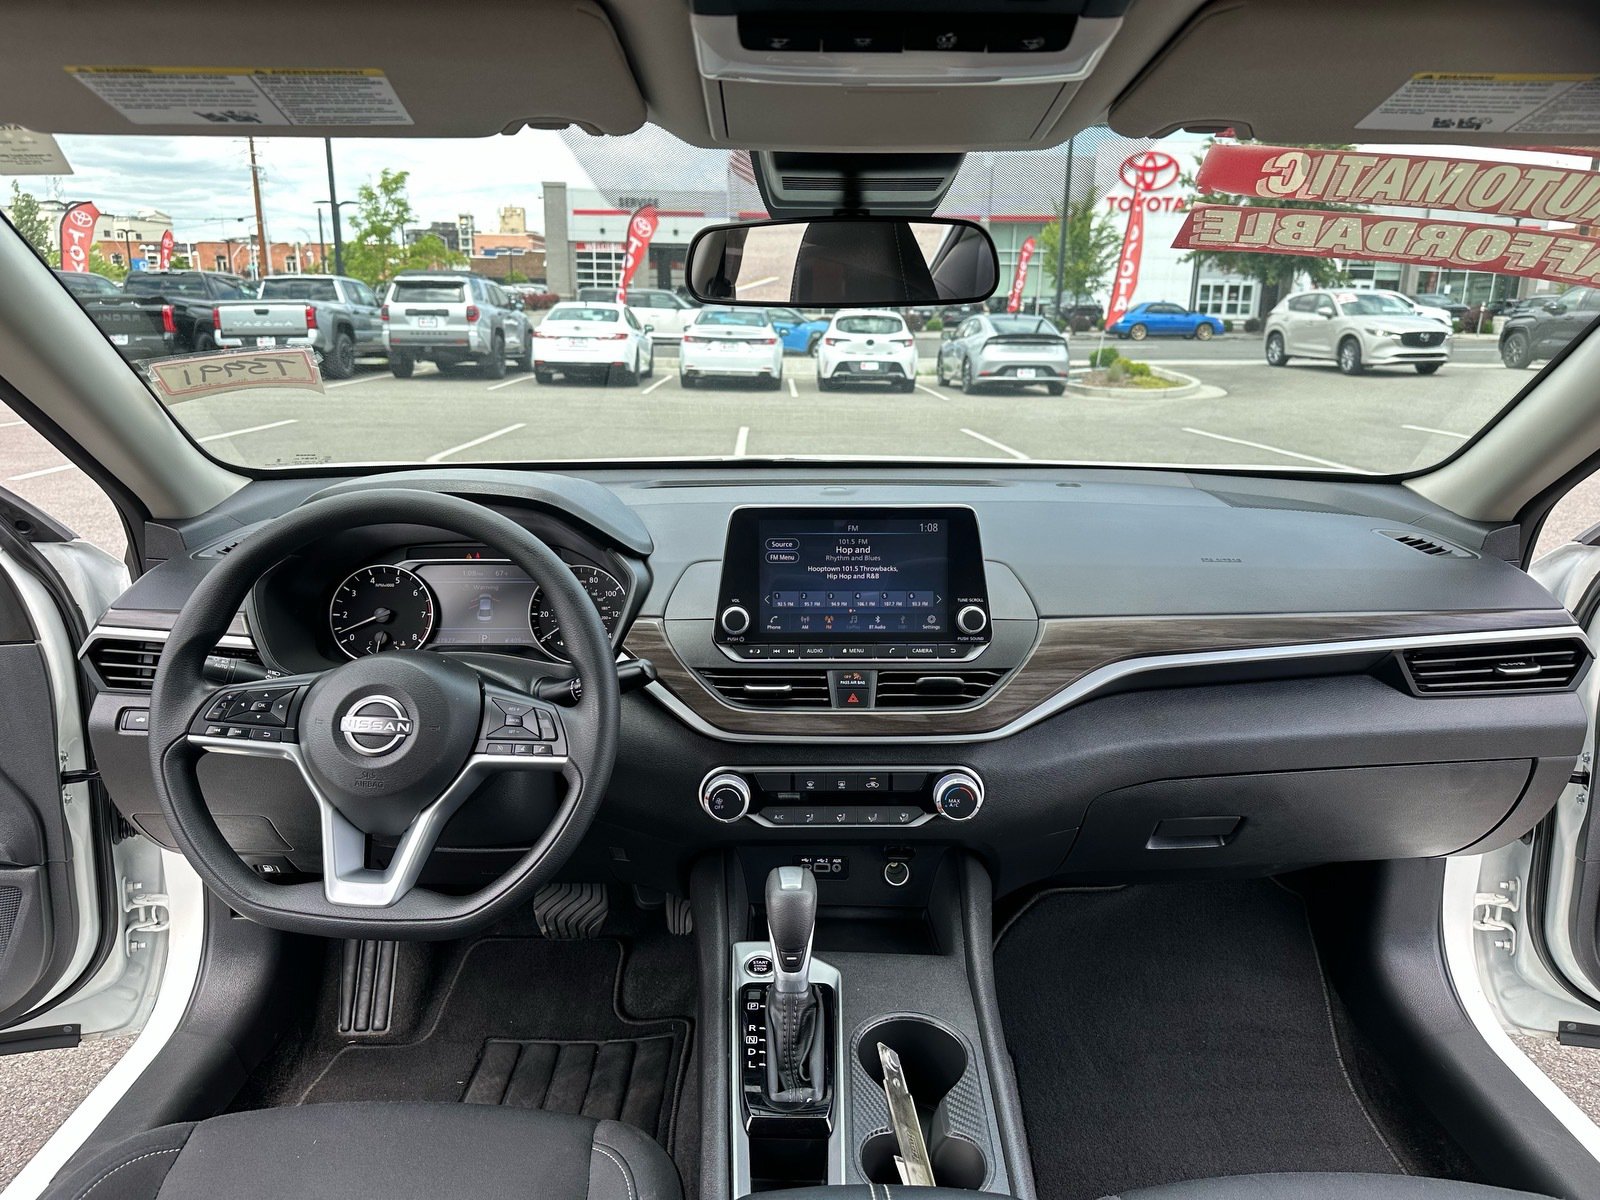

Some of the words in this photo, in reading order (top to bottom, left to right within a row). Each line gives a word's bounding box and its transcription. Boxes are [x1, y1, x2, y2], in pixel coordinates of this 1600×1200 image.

[919, 523, 938, 532] 1:08
[771, 540, 793, 548] Source
[835, 546, 853, 555] Hop
[854, 546, 871, 554] and
[807, 565, 841, 573] Hooptown
[859, 565, 899, 573] Throwbacks,
[473, 584, 499, 592] Warning
[351, 589, 357, 597] 3
[412, 589, 418, 597] 6
[342, 611, 348, 619] 2
[349, 633, 355, 641] 0
[412, 633, 418, 641] 8
[341, 718, 411, 732] NISSAN
[354, 780, 384, 789] AIRBAG
[749, 1024, 757, 1032] R
[748, 1061, 756, 1069] L
